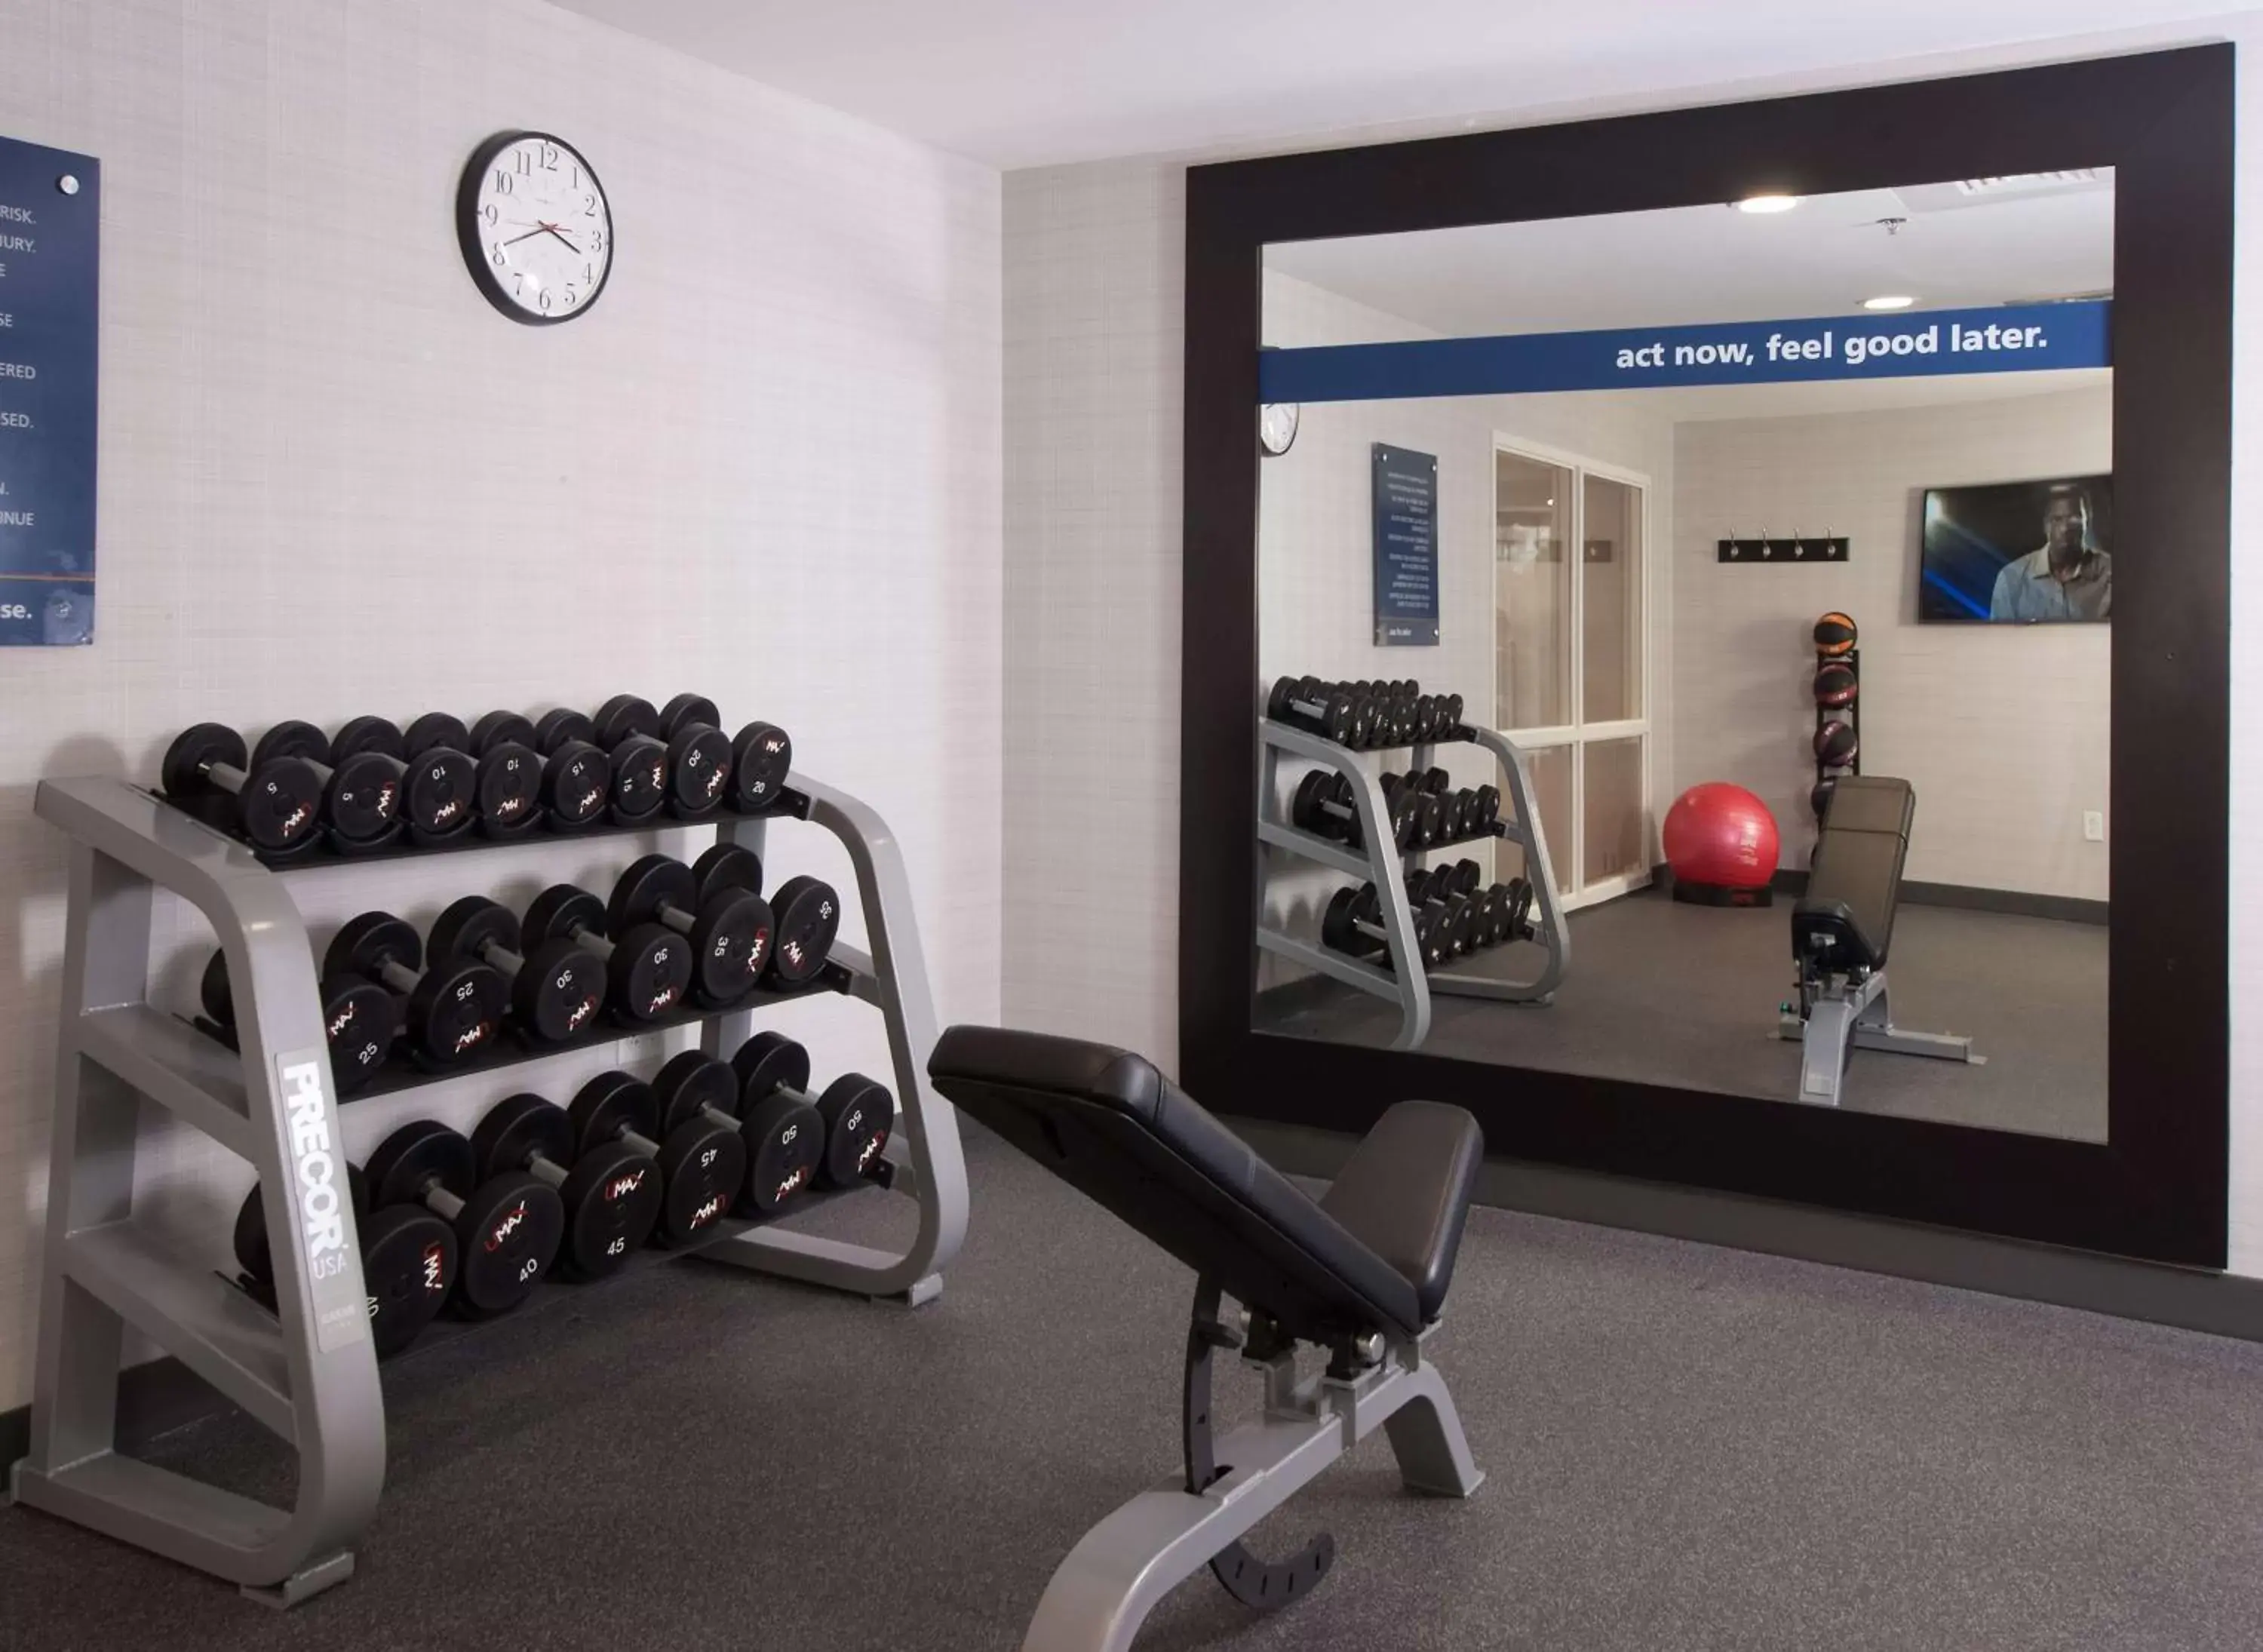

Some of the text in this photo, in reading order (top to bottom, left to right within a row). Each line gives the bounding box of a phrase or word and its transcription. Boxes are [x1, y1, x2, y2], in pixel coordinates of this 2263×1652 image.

[515, 150, 531, 177] 11
[538, 145, 558, 172] 12
[496, 170, 513, 195] 10
[572, 167, 578, 189] 1
[485, 204, 499, 226] 9
[585, 194, 596, 217] 2
[591, 229, 602, 253] 3
[493, 242, 505, 266] 8
[513, 272, 524, 296] 7
[582, 263, 594, 285] 4
[539, 287, 551, 310] 6
[565, 282, 576, 304] 5
[1616, 322, 2047, 369] act now, feel good later.
[0, 603, 32, 619] se.
[507, 758, 519, 771] 10
[689, 748, 701, 767] 20
[432, 766, 447, 780] 10
[752, 780, 766, 794] 20
[654, 948, 668, 965] 30
[714, 936, 729, 957] 35
[456, 981, 474, 1001] 25
[556, 970, 573, 990] 30
[358, 1042, 378, 1064] 25
[847, 1110, 862, 1131] 50
[781, 1125, 797, 1145] 50
[283, 1061, 345, 1259] PRECOR
[701, 1148, 717, 1168] 45
[606, 1236, 625, 1255] 45
[313, 1252, 349, 1280] USA
[519, 1258, 538, 1283] 40
